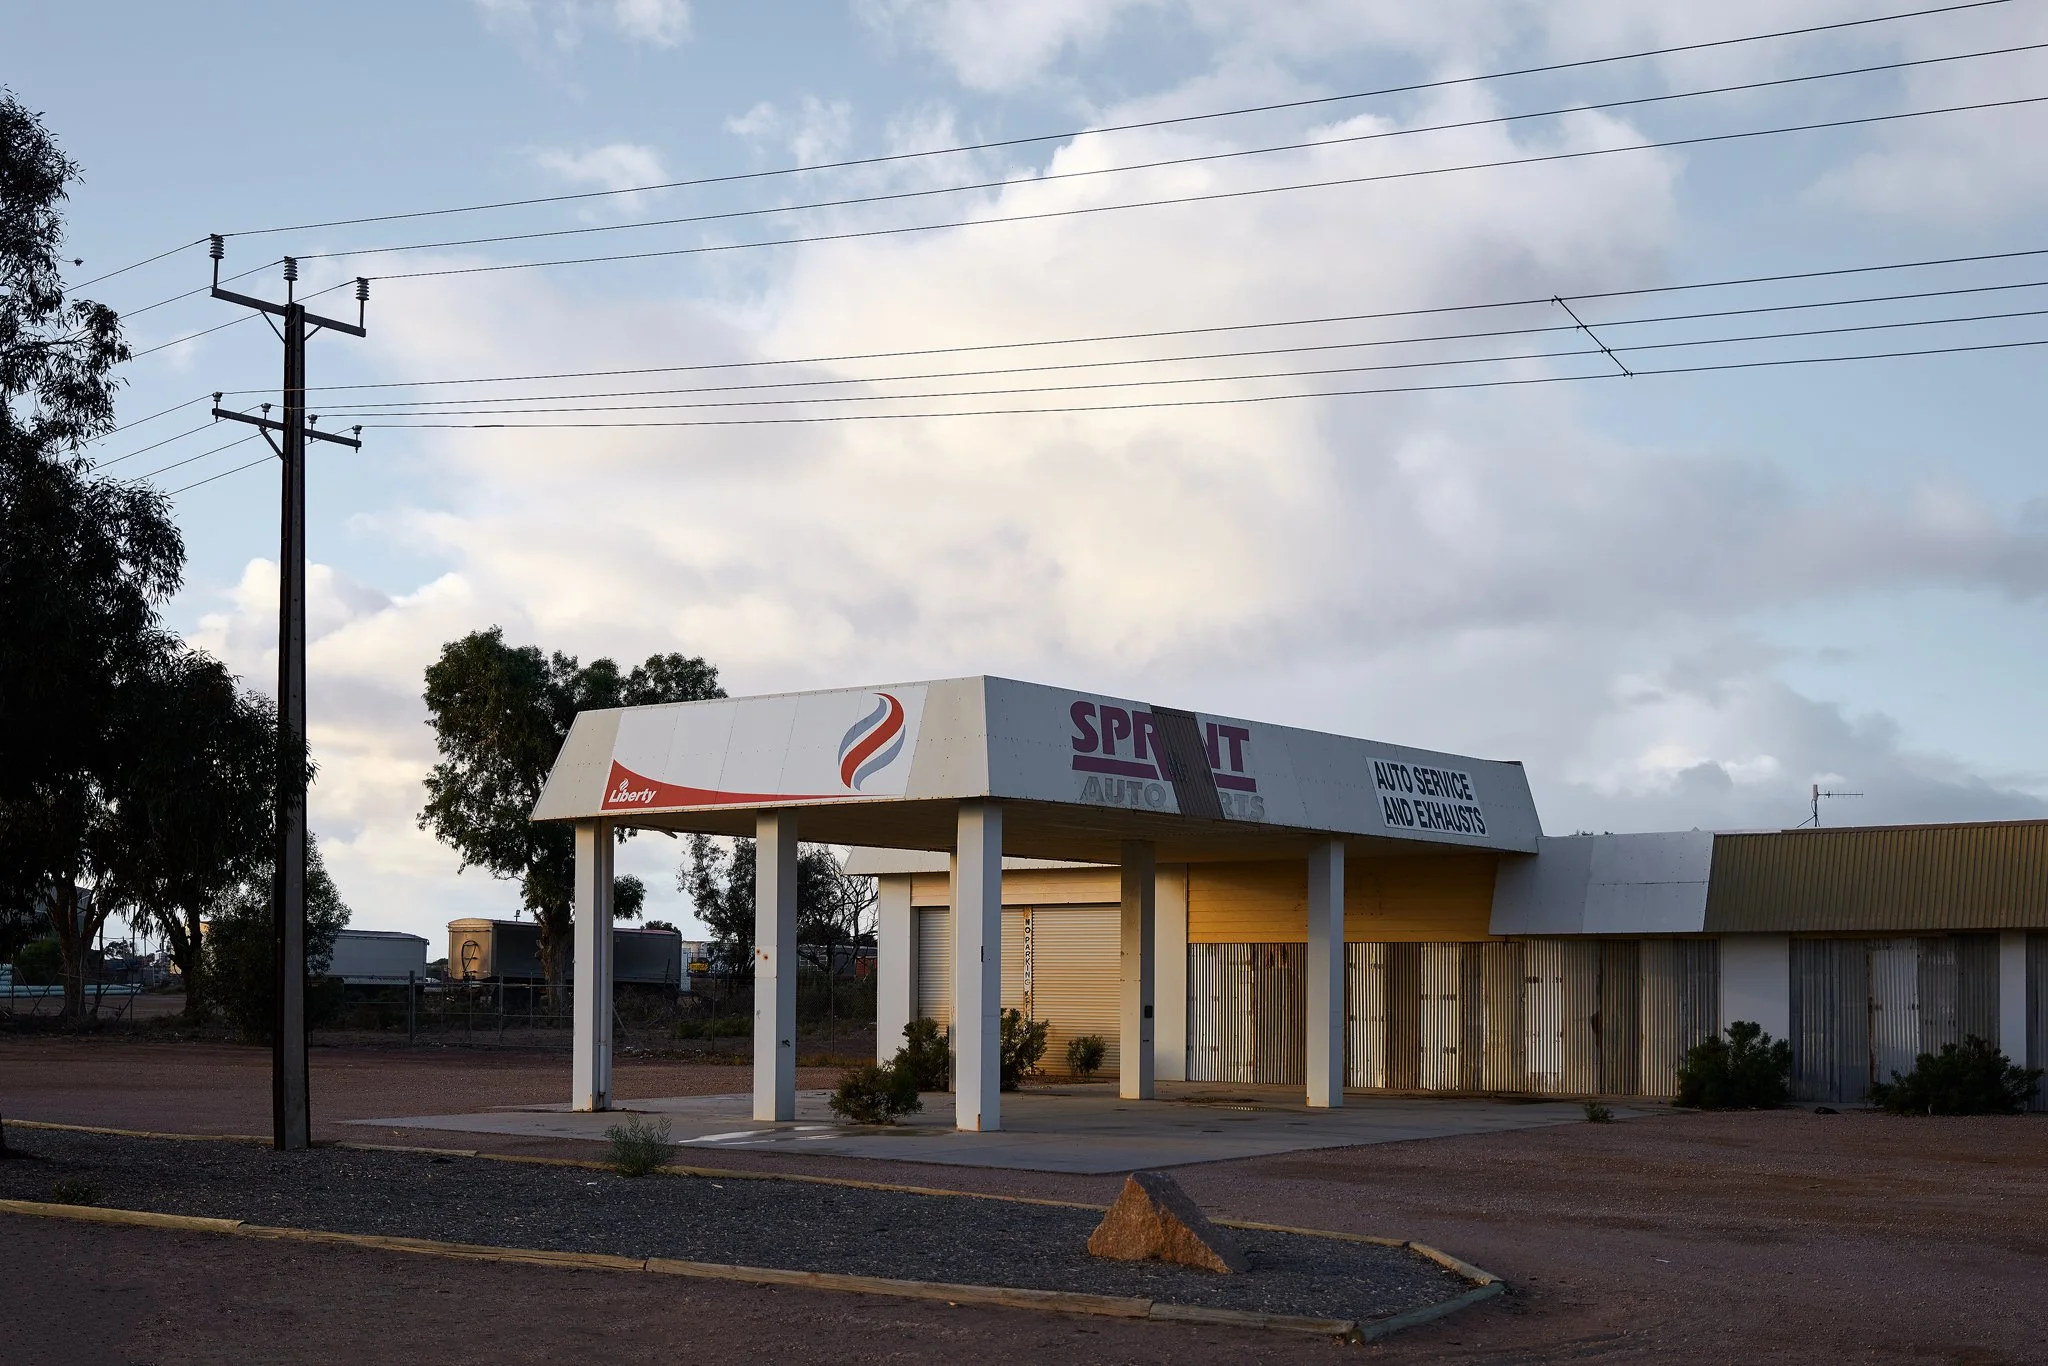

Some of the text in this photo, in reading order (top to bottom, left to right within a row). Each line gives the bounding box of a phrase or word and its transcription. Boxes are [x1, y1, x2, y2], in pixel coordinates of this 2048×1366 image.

[1070, 700, 1250, 782] SPRT
[608, 787, 657, 804] Liberty
[1080, 776, 1265, 819] AUTO RTS
[1374, 761, 1473, 801] AUTO SERVICE
[1383, 796, 1486, 835] AND EXHAUSTS
[1024, 919, 1031, 934] NO
